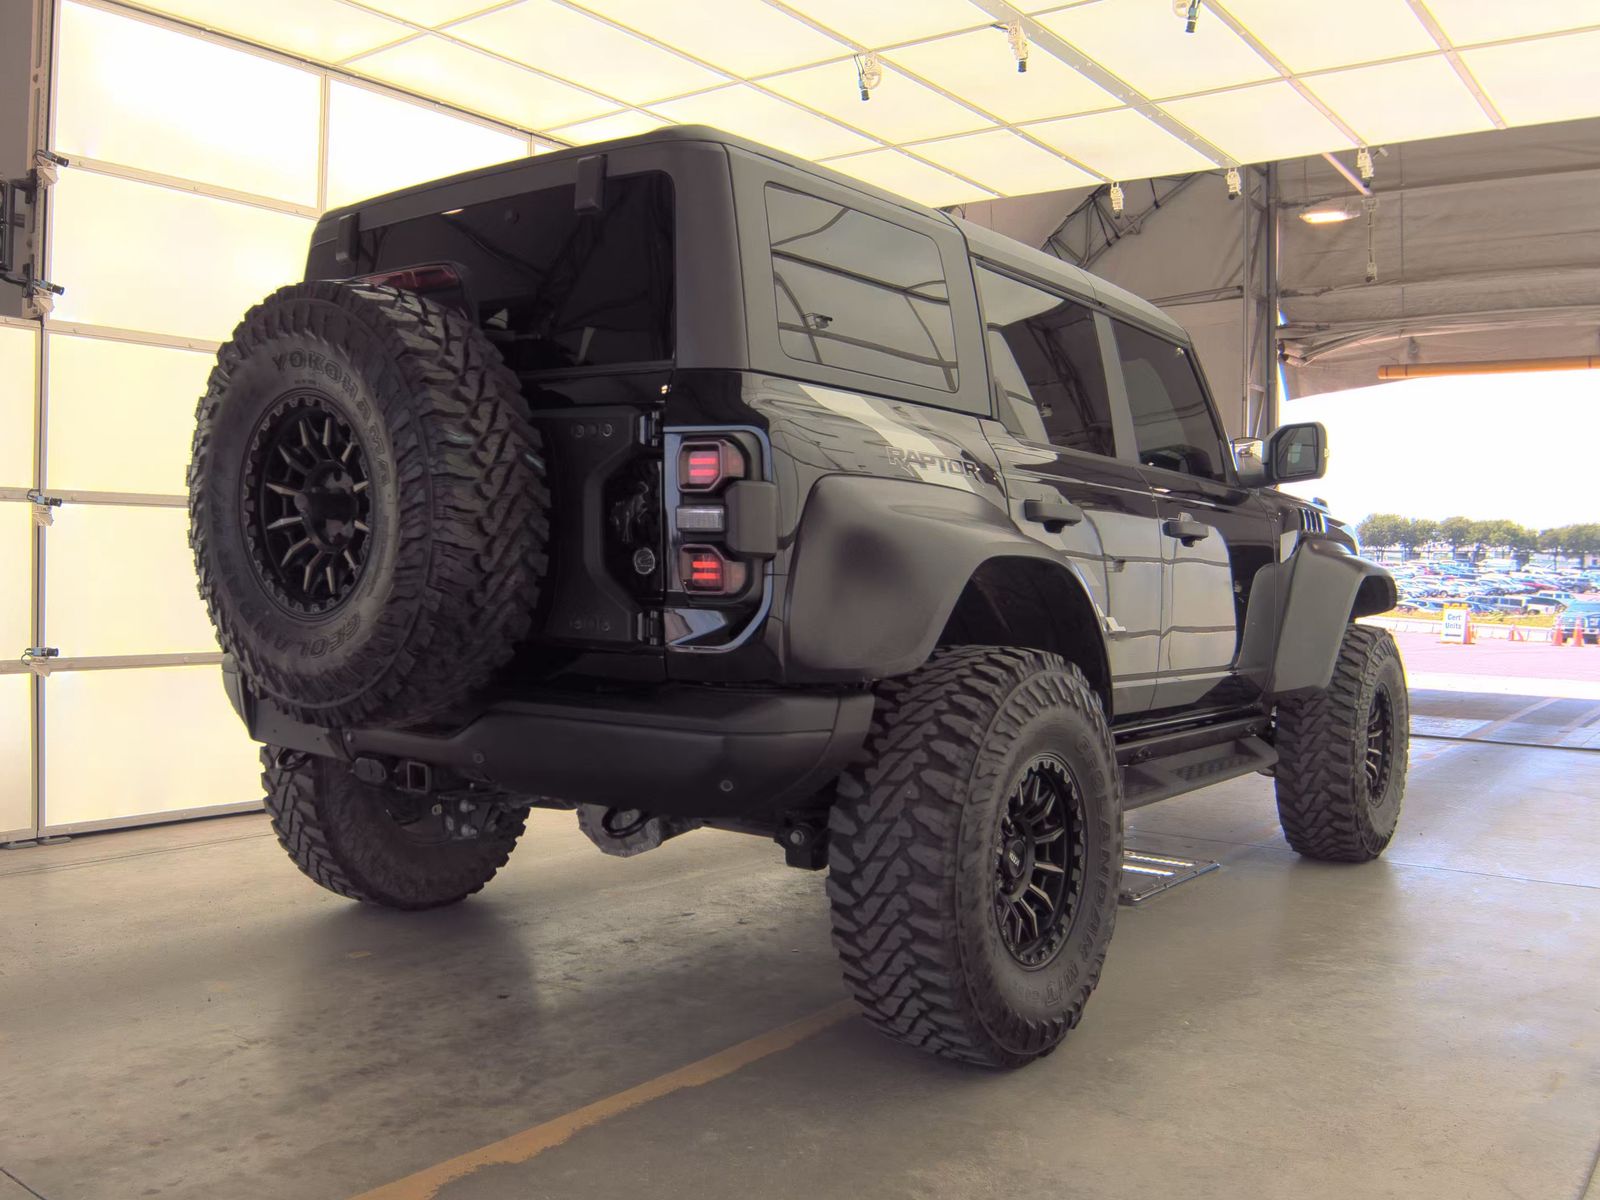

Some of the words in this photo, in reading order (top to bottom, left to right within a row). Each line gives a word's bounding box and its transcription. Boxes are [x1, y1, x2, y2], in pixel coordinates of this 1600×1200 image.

[272, 347, 390, 486] YOKOHAMA
[887, 448, 983, 486] RAPTOR
[1445, 622, 1462, 630] Units
[1448, 613, 1462, 621] Cert
[1074, 735, 1112, 961] GEOLANDAR
